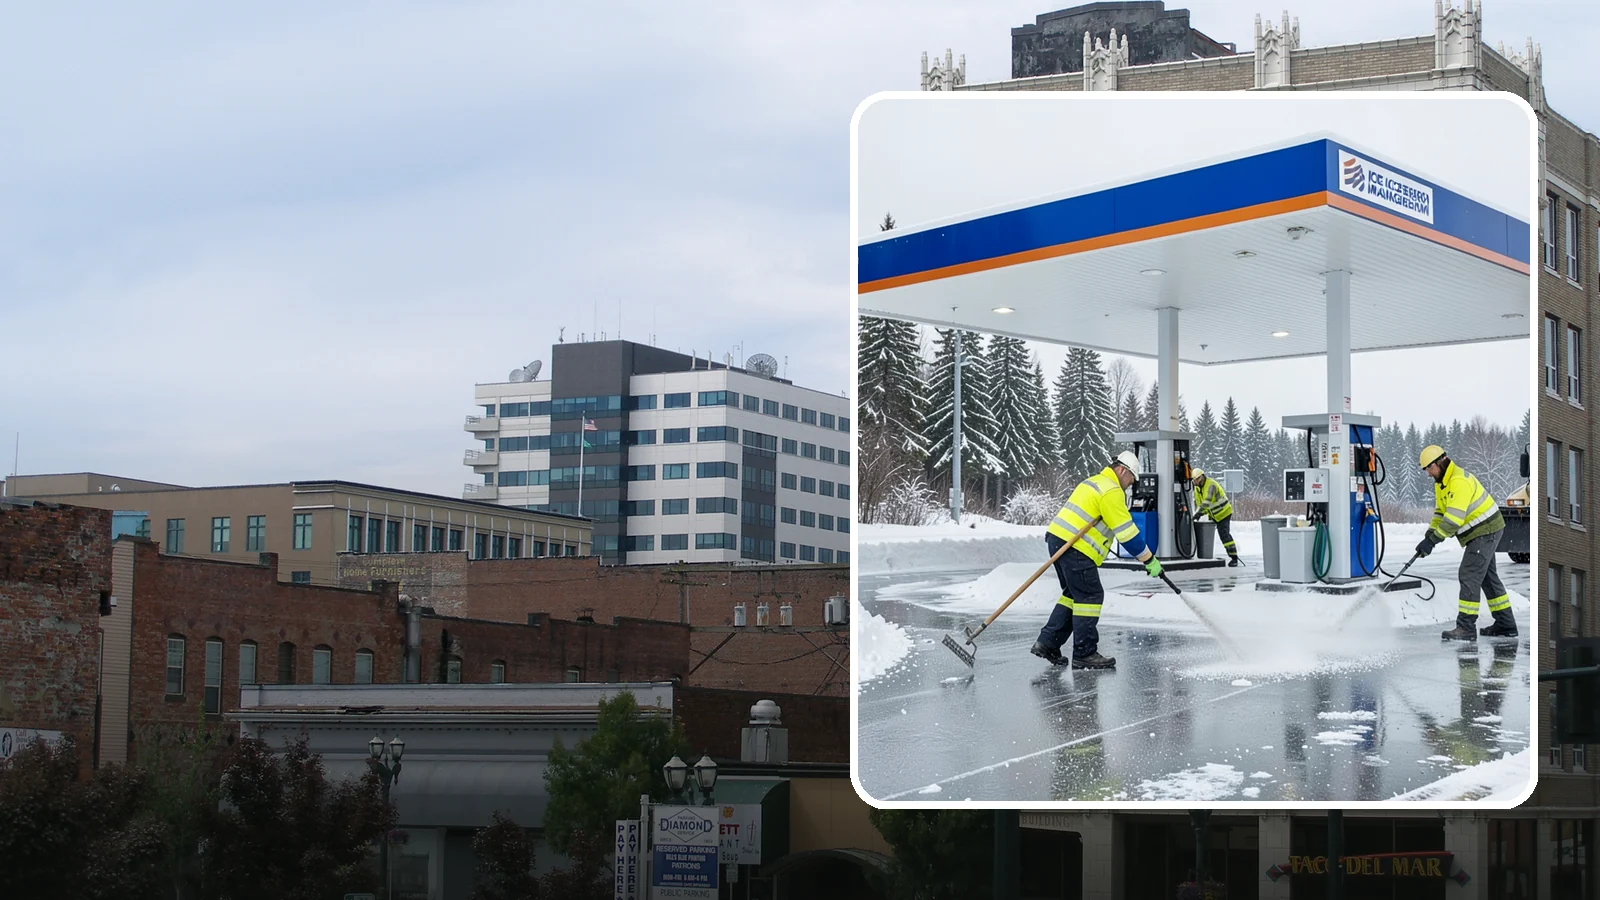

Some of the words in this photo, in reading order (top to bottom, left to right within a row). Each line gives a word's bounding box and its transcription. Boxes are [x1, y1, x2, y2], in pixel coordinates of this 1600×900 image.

[343, 568, 367, 577] Home
[370, 566, 428, 576] Furnishers
[660, 818, 713, 832] DIAMOND
[1022, 815, 1070, 828] BUILDING
[617, 825, 625, 852] PAY
[628, 825, 637, 852] PAY
[656, 845, 688, 853] RESERVED
[721, 851, 739, 863] Soup
[671, 862, 701, 870] PATRONS
[1346, 857, 1385, 875] DEL
[1392, 857, 1443, 877] MAR
[616, 856, 625, 894] HERE
[628, 856, 637, 893] HERE
[660, 889, 682, 897] PUBLIC
[683, 890, 710, 898] PARKING
